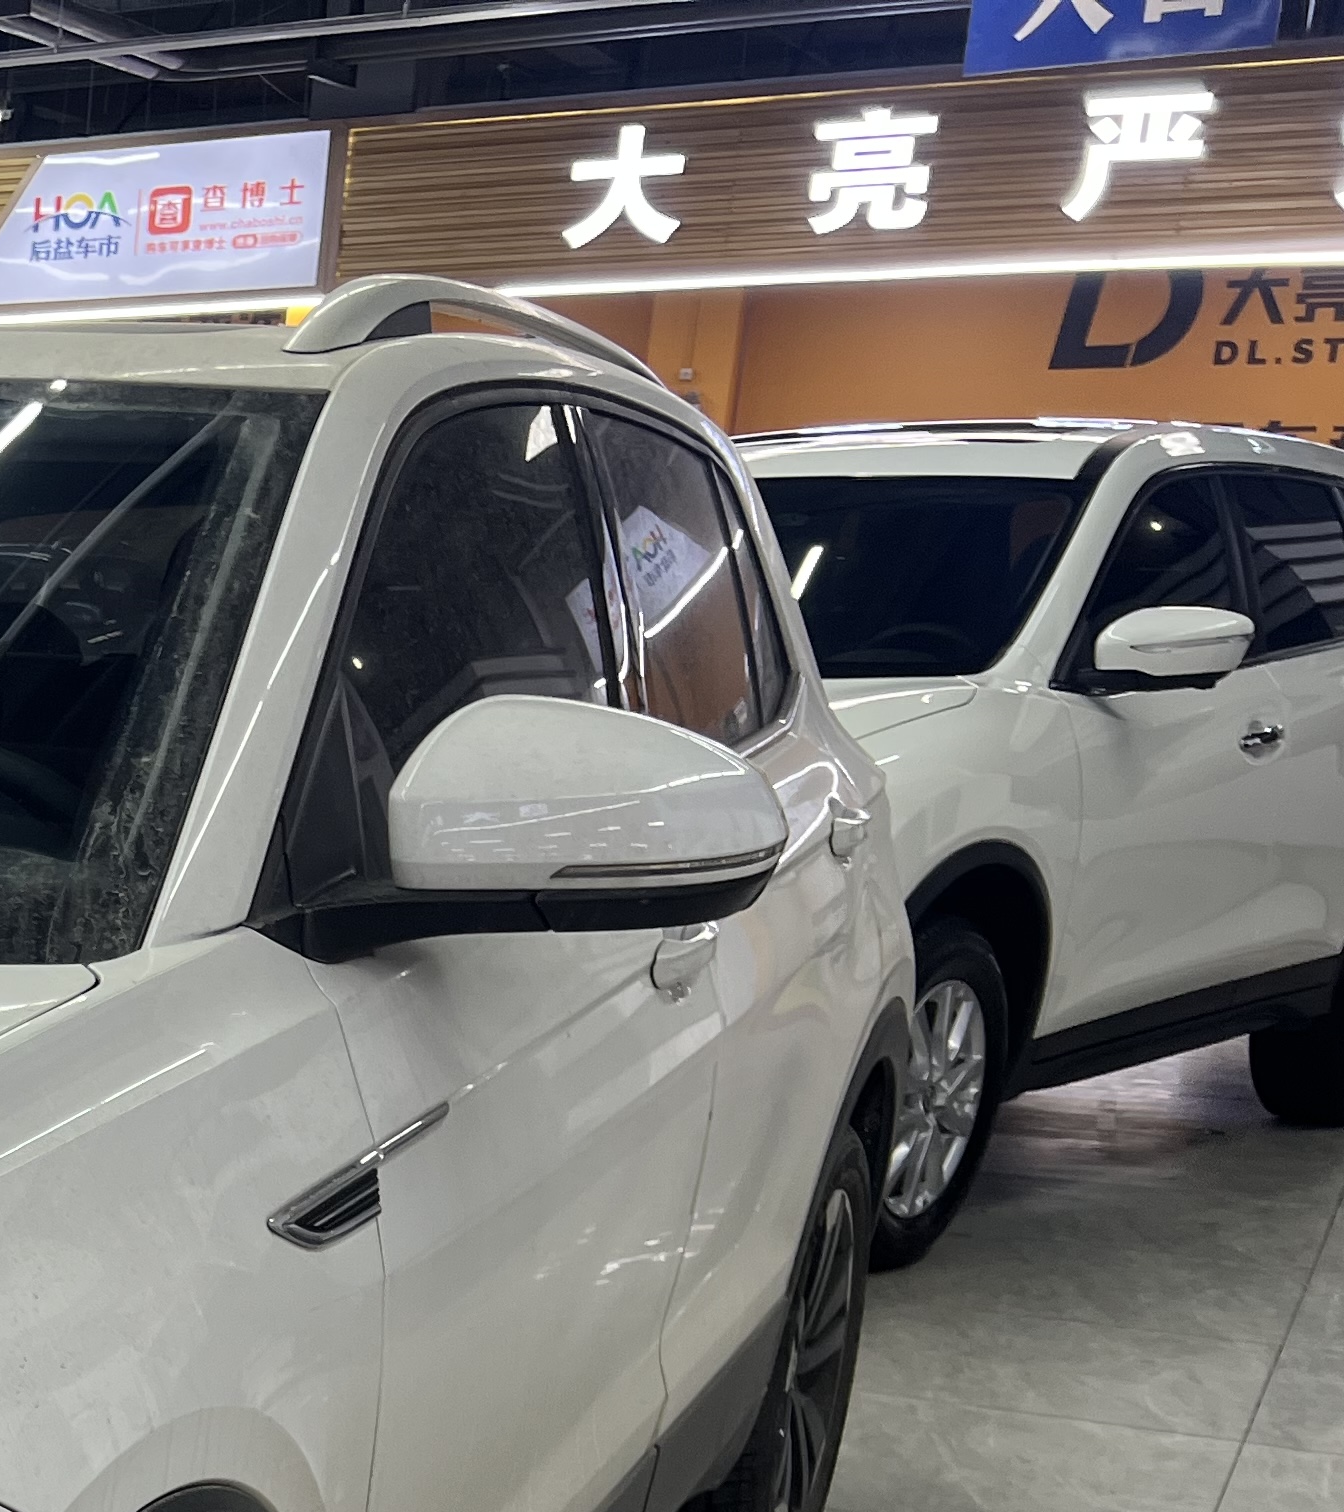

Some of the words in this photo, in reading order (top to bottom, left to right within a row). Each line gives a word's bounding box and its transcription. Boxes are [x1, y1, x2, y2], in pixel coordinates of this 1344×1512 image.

[561, 90, 1344, 250] 大亮严
[201, 178, 305, 212] 查博士
[28, 235, 122, 262] 后盐车市
